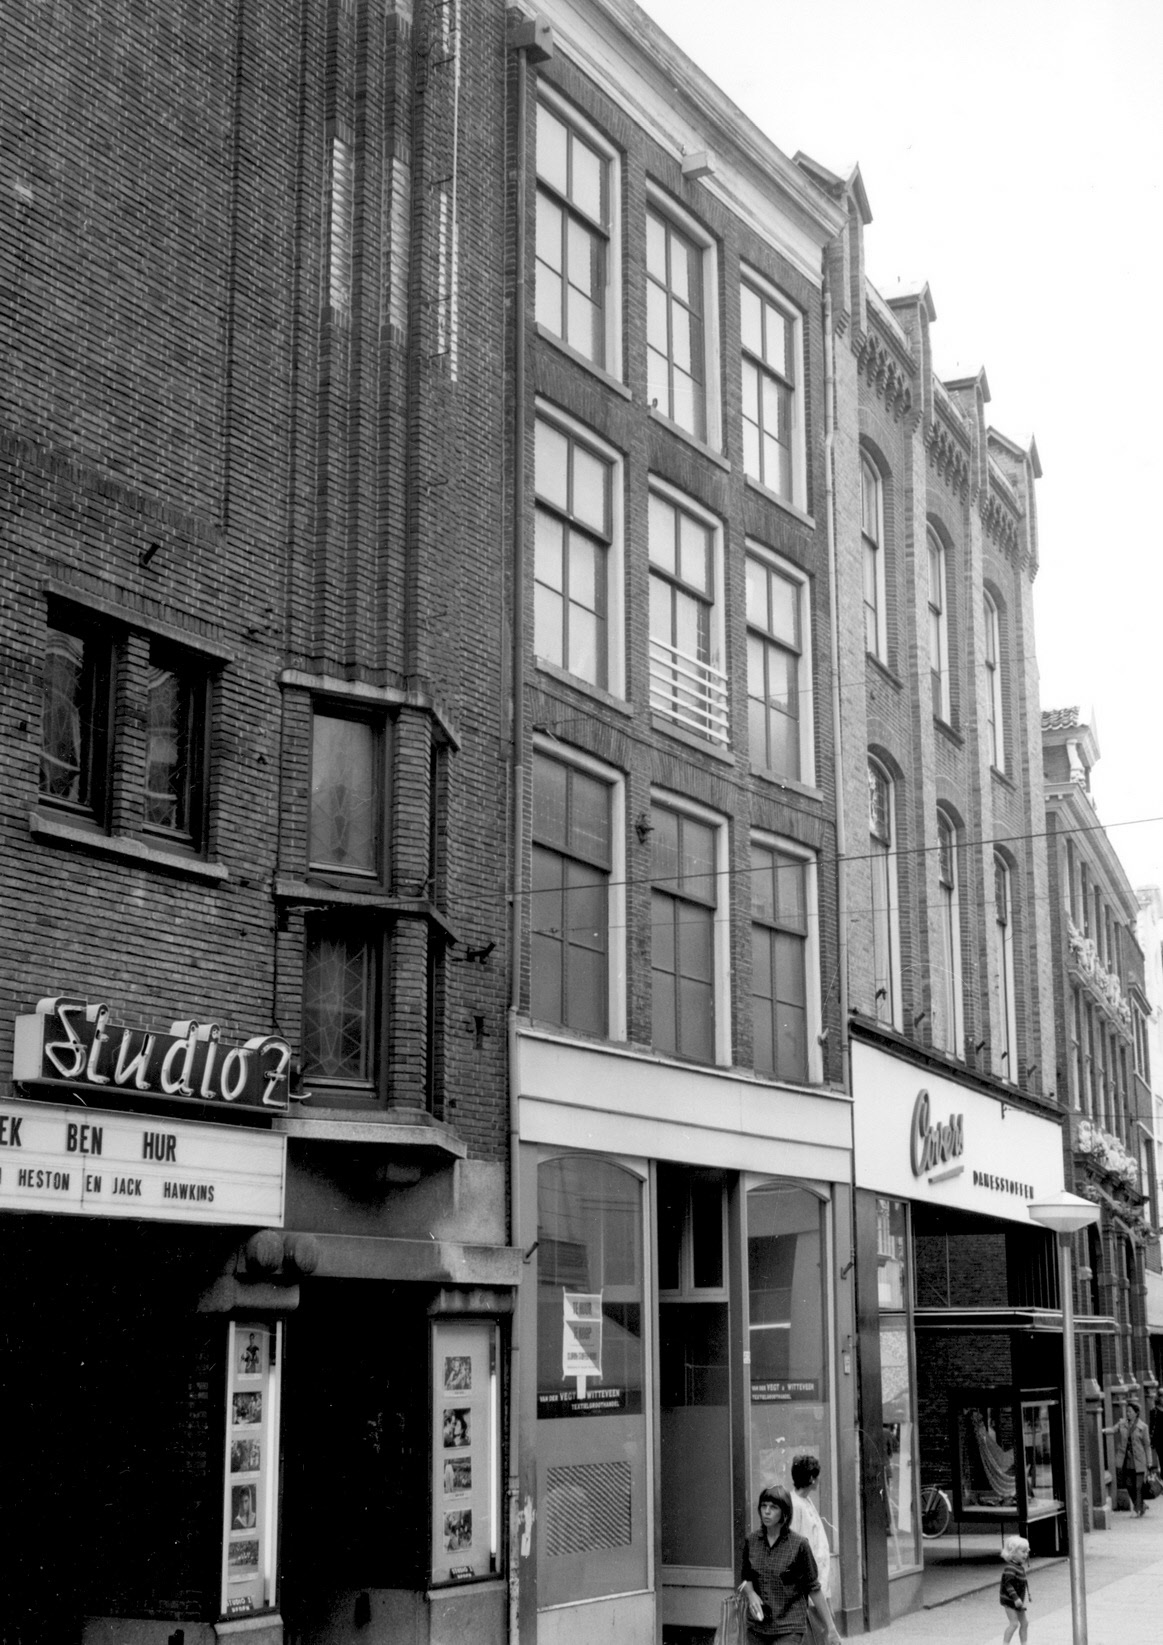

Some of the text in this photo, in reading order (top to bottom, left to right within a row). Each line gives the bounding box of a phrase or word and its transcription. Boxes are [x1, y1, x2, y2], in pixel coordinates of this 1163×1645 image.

[45, 1002, 252, 1101] Studio
[66, 1123, 103, 1155] BEN
[142, 1131, 177, 1162] HUR
[19, 1168, 70, 1191] HESTON
[86, 1174, 102, 1193] EN
[112, 1177, 142, 1197] JACK
[163, 1181, 215, 1202] HAWKINS
[973, 1170, 1034, 1200] DAMESSTOFFEN
[560, 1391, 576, 1401] VEGT
[587, 1389, 620, 1399] WITTEVEEN
[766, 1383, 779, 1391] VEGT
[787, 1383, 814, 1391] WITTEVEEN
